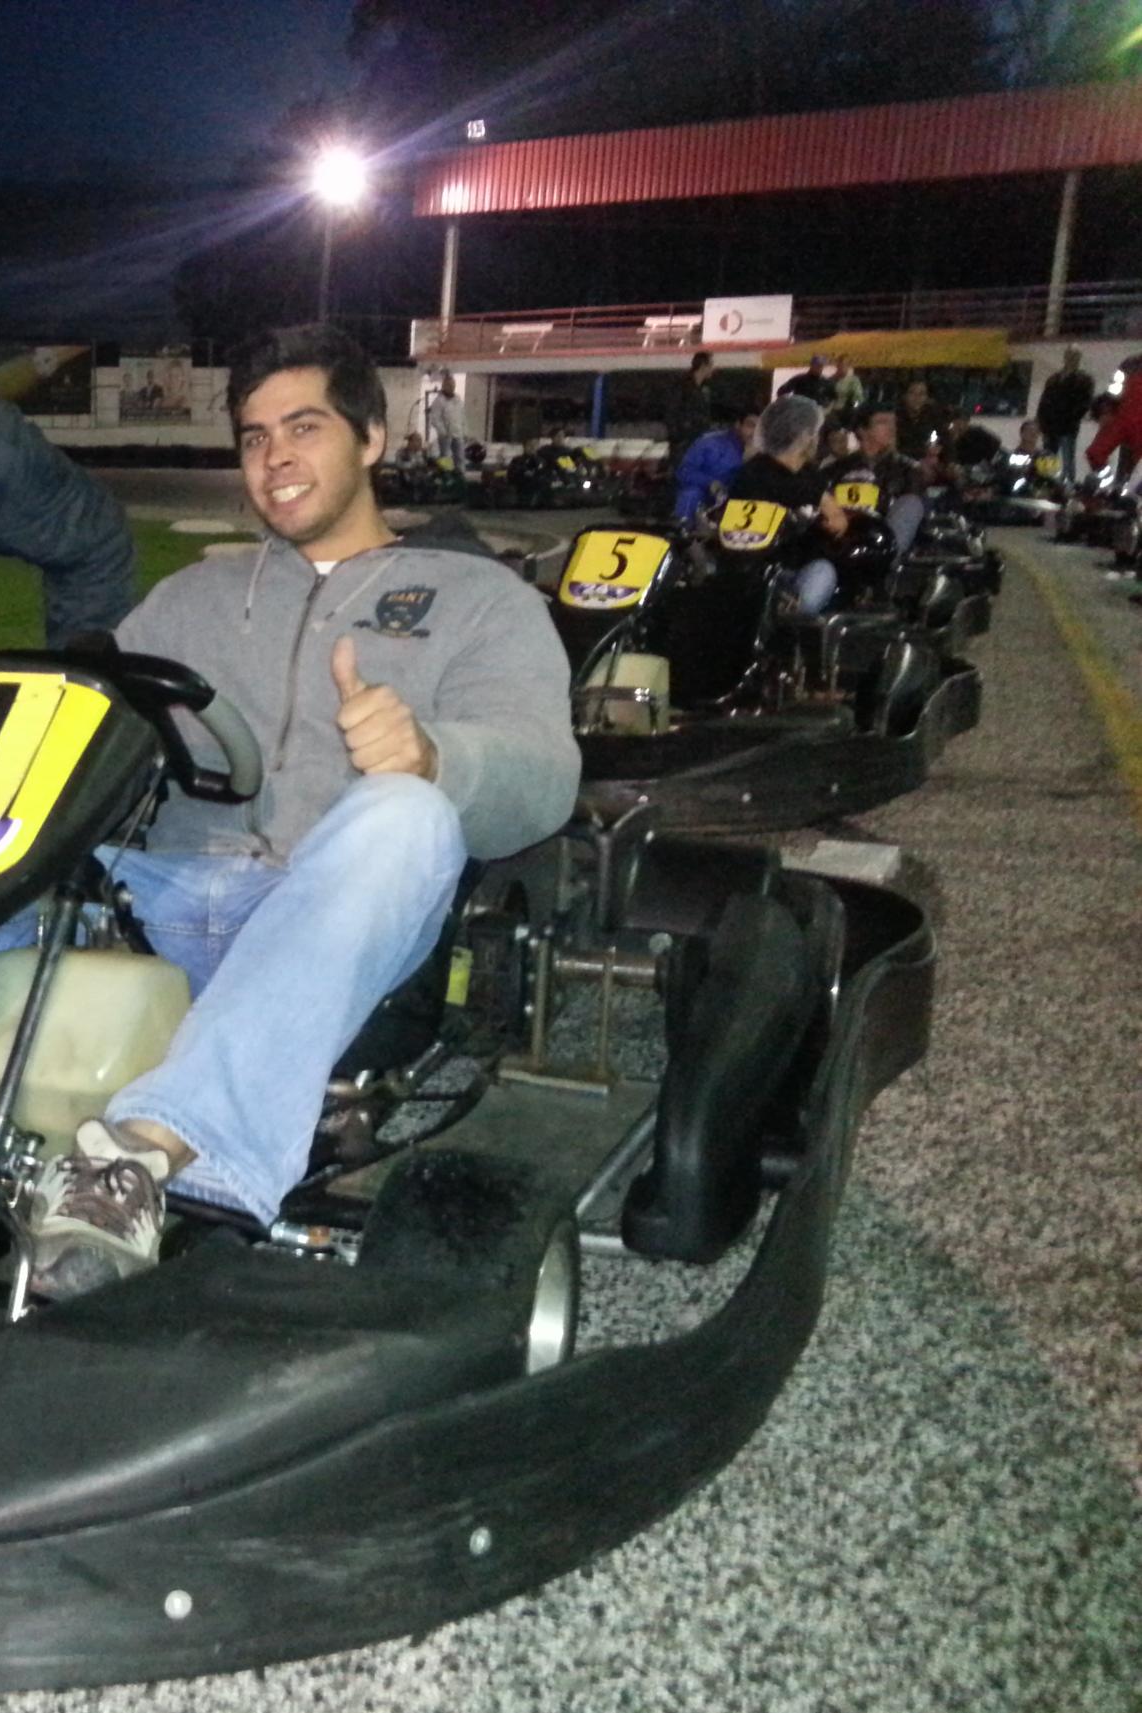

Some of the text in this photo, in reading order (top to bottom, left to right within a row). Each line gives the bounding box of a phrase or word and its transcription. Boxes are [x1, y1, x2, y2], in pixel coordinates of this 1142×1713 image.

[847, 485, 861, 504] 6
[734, 502, 757, 530] 3
[598, 537, 637, 580] 5
